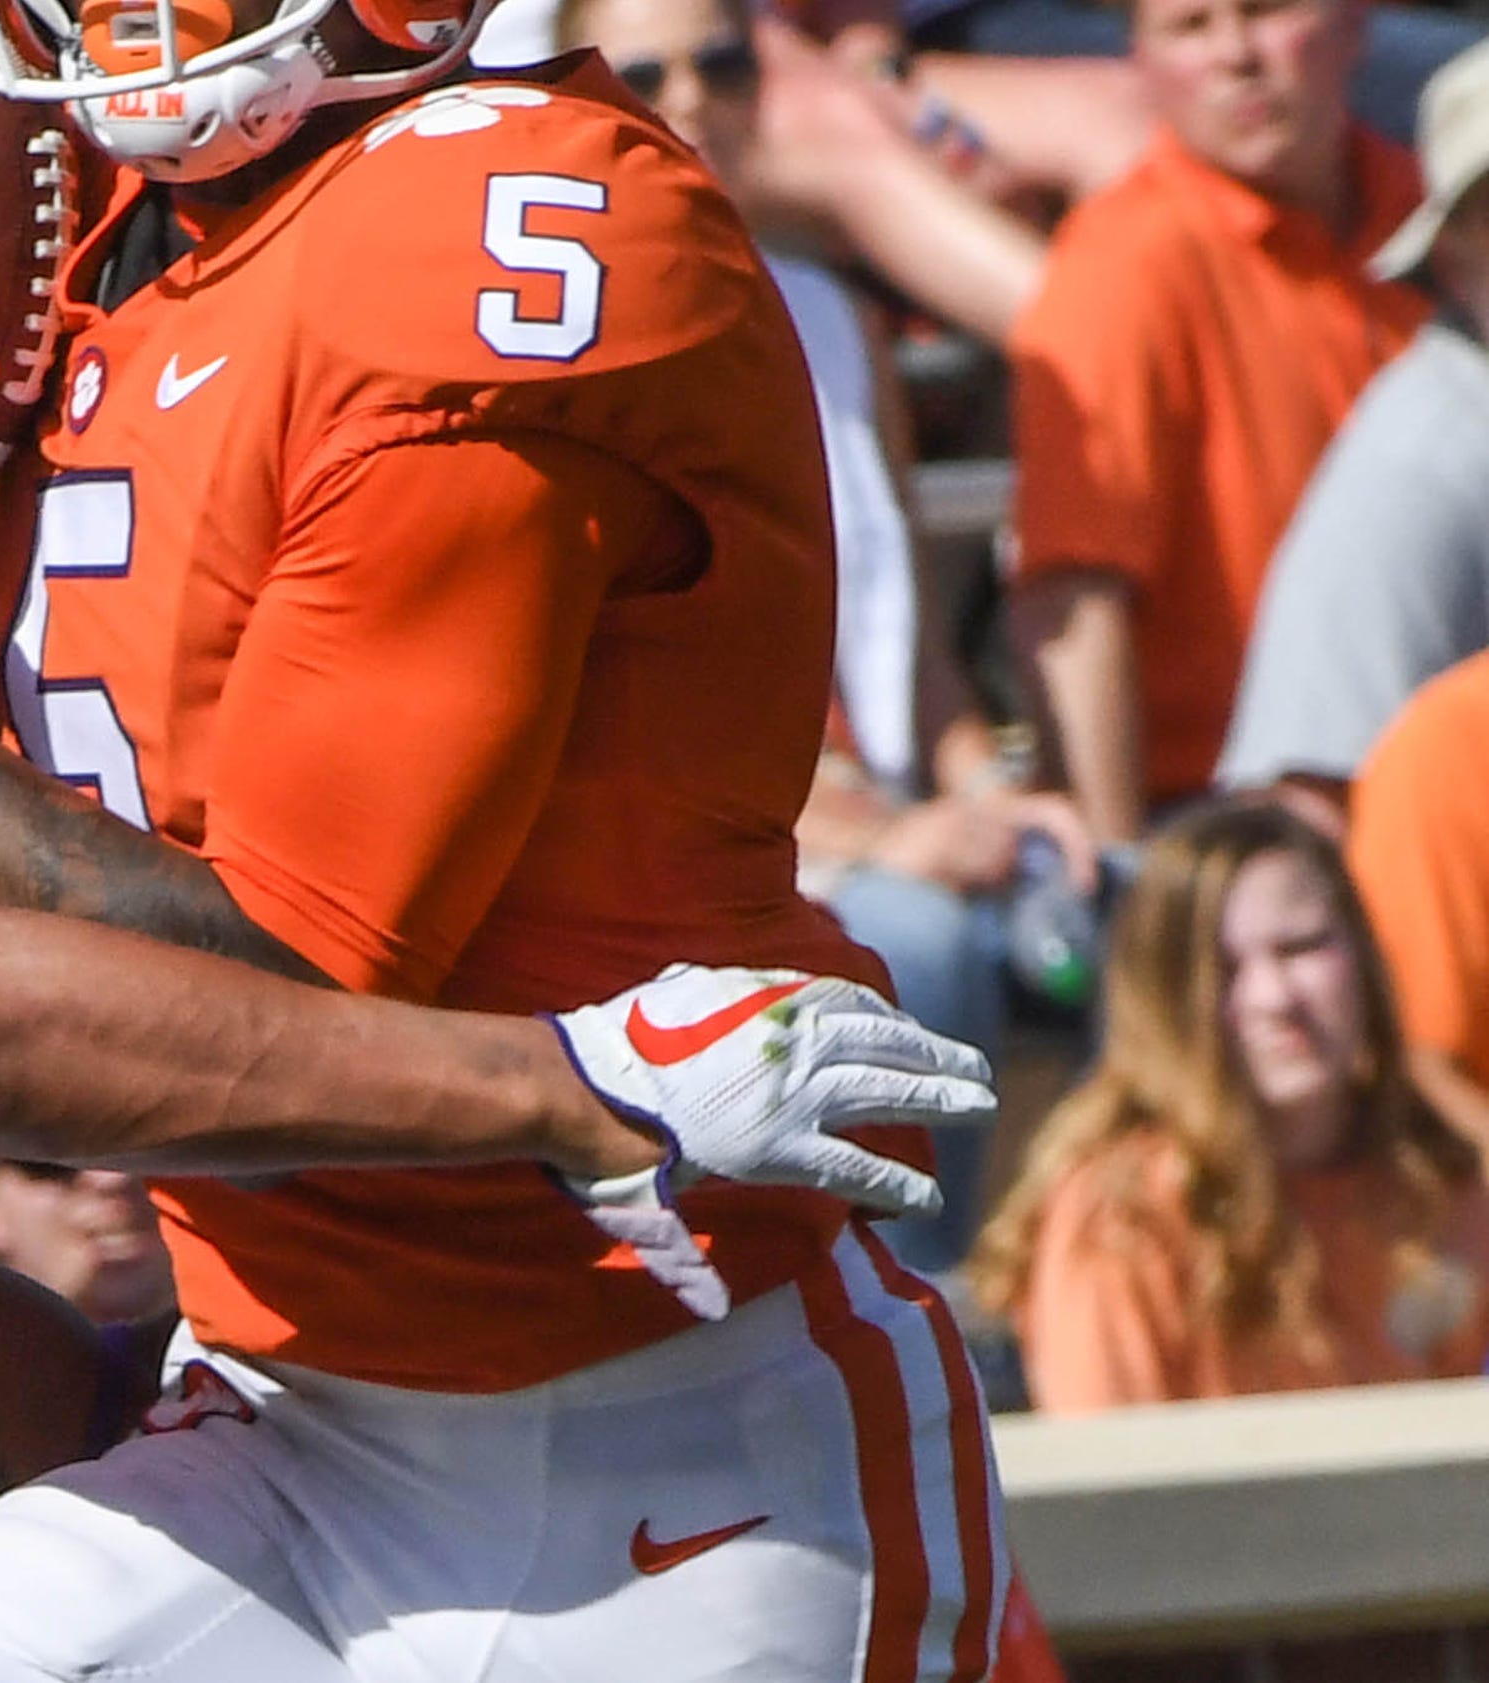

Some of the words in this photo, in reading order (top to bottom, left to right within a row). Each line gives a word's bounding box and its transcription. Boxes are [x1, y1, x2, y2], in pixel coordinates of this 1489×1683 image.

[106, 90, 148, 117] ALL
[157, 92, 184, 117] IN
[475, 171, 608, 363] 5
[4, 468, 154, 832] 5
